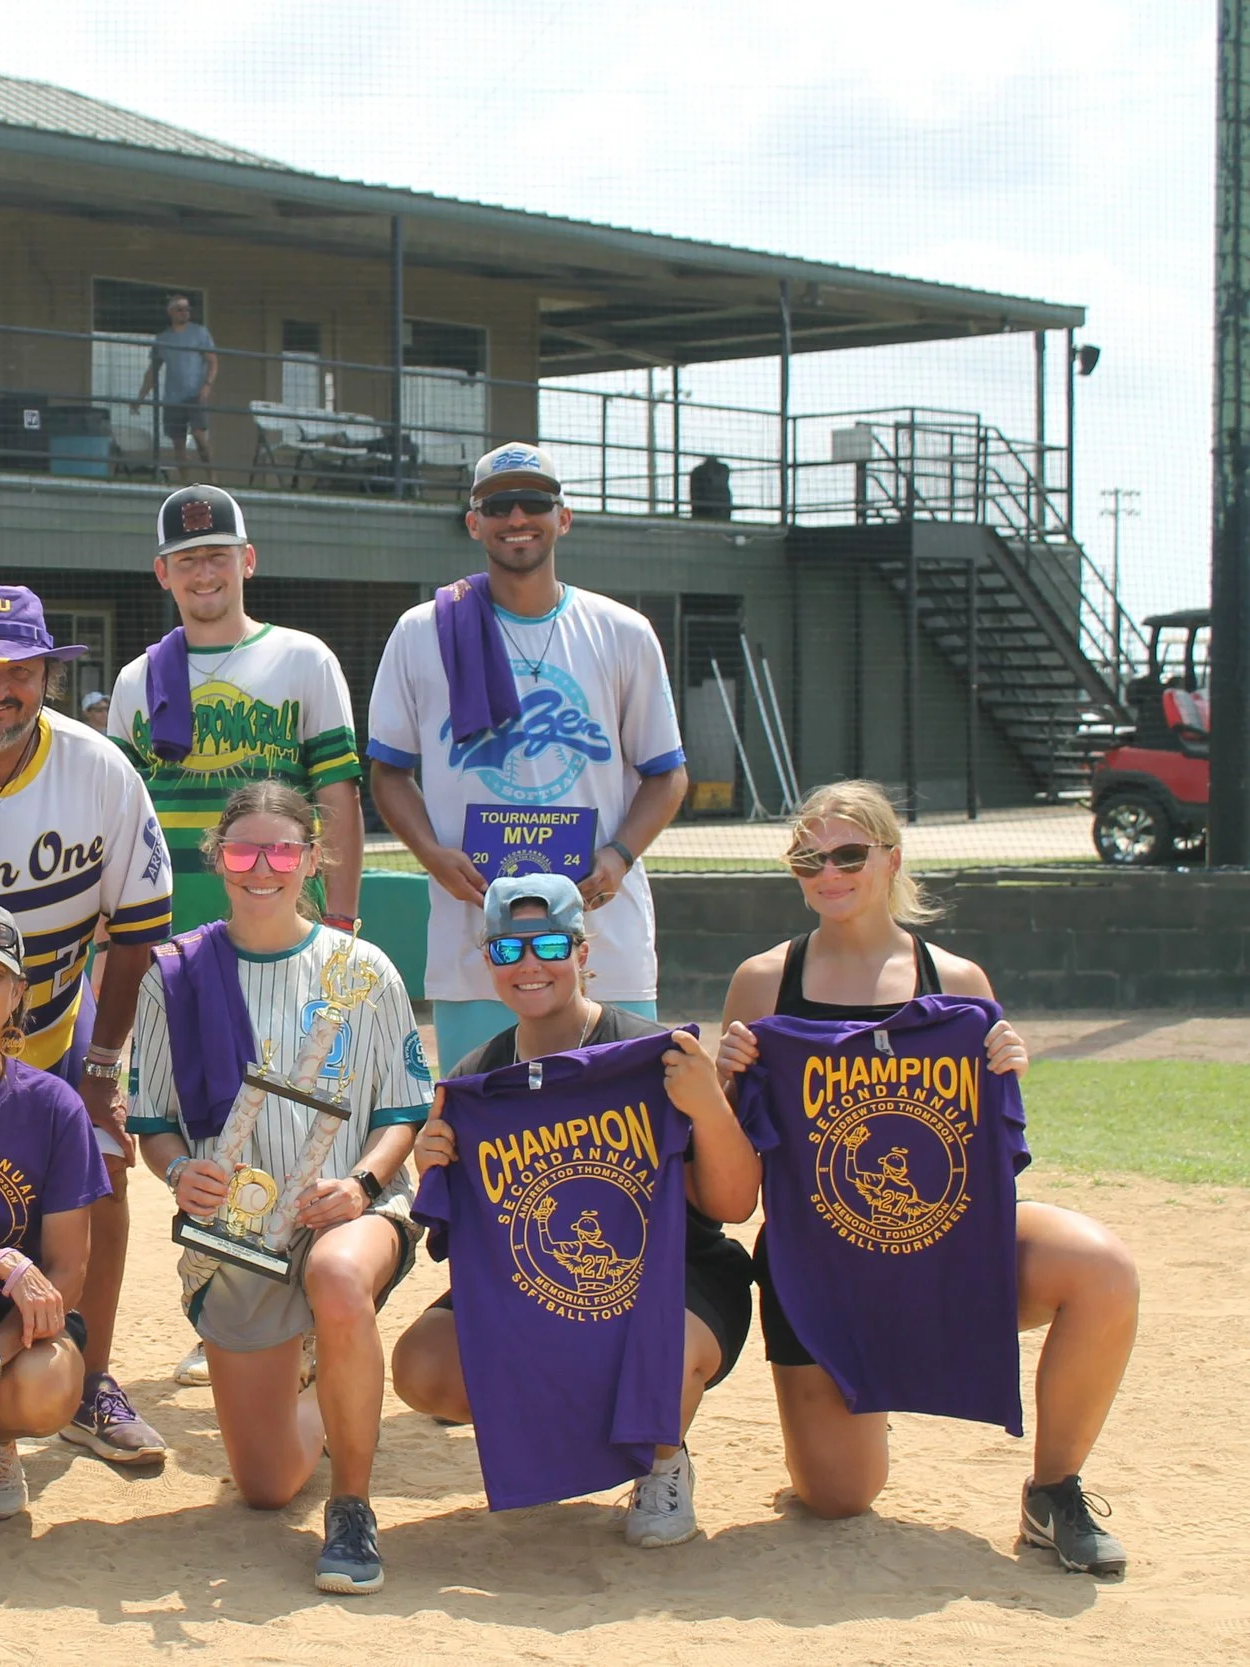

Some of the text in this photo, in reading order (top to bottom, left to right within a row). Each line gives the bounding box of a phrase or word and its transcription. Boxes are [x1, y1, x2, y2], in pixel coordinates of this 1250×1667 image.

[480, 812, 580, 825] TOURNAMENT
[503, 827, 553, 844] MVP
[28, 830, 103, 881] One
[472, 852, 489, 864] 20
[563, 854, 580, 866] 24
[803, 1056, 978, 1126] CHAMPION
[808, 1085, 973, 1144] SECOND ANNUAL
[830, 1103, 955, 1143] ANDREW TOD THOMPSON
[478, 1102, 659, 1204] CHAMPION
[498, 1148, 655, 1224] SECOND ANNUAL
[518, 1166, 639, 1219] ANDREW TOD THOMPSON
[879, 1189, 909, 1216] 27
[810, 1193, 972, 1254] SOFTBALL TOURNAMENT
[833, 1202, 950, 1239] MEMORIAL FOUNDATION
[534, 1262, 645, 1306] MEMORIAL FOUNDATIO
[582, 1255, 609, 1279] 27
[511, 1272, 586, 1321] SOFTBALL
